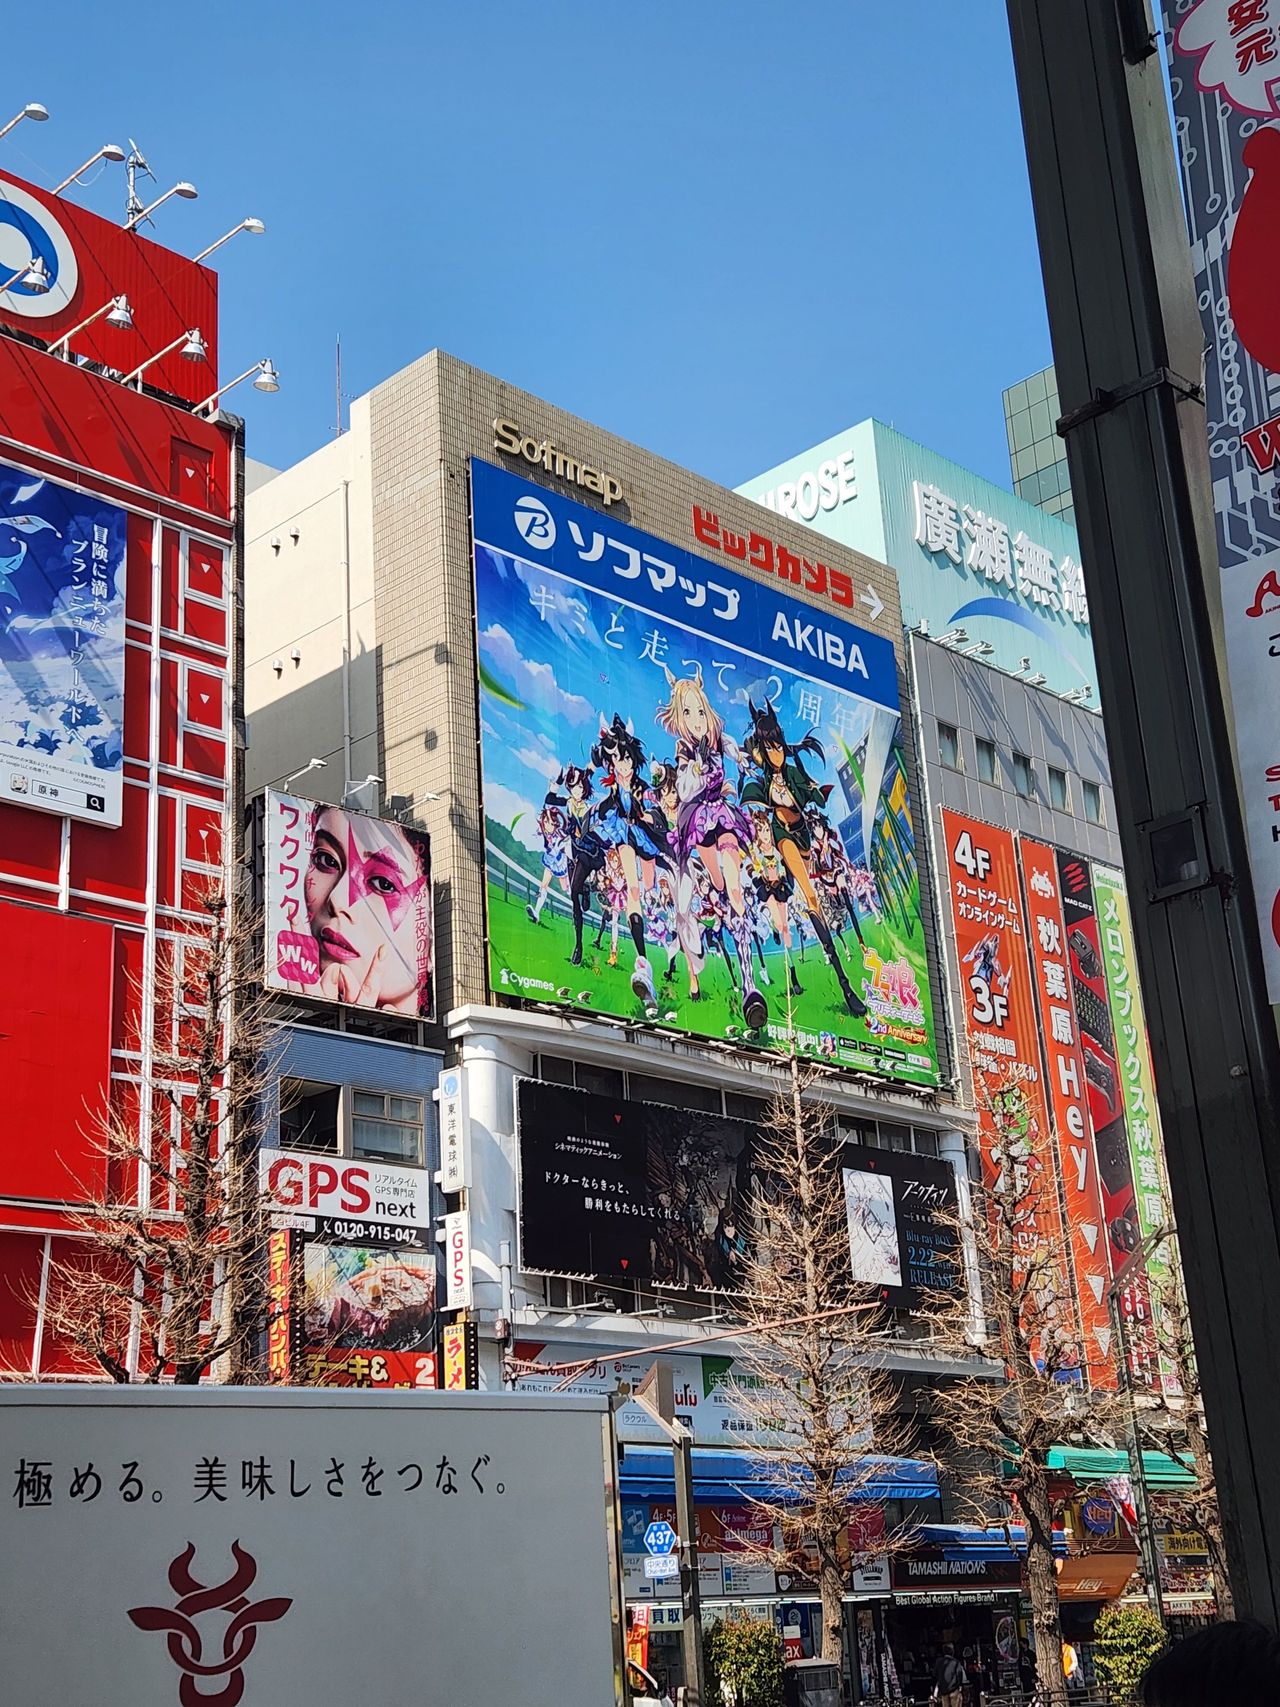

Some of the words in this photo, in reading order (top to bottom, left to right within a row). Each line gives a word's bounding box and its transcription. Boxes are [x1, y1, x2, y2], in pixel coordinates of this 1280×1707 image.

[492, 418, 623, 506] Sofmap
[693, 504, 854, 608] ビックカメラ
[91, 523, 109, 635] 冒険に満ちた
[567, 520, 740, 621] ソフマップ
[771, 612, 870, 680] AKIBA
[65, 538, 88, 743] ブランニューワールドへ
[37, 784, 59, 797] 原神
[279, 802, 300, 921] ワクワク
[954, 831, 991, 880] 4F
[957, 880, 1018, 914] カードゲーム
[958, 902, 1022, 935] オンラインゲーム
[510, 972, 555, 991] Cygames
[970, 977, 1009, 1027] 3F
[888, 1023, 928, 1044] Anniversary
[1036, 914, 1075, 1047] 秋葉原
[1056, 1055, 1088, 1191] Hey
[268, 1158, 371, 1215] GPS
[374, 1173, 418, 1189] リアルタイム
[544, 1170, 630, 1195] ドクターならきっと、
[375, 1201, 416, 1219] next
[584, 1196, 686, 1222] 勝利をもたらしてくれる。
[334, 1221, 417, 1243] 0120-915-047
[452, 1231, 464, 1287] GPS
[446, 1336, 462, 1390] ラーメ
[12, 1458, 163, 1508] 極める。
[193, 1454, 506, 1504] 美味しさをつなぐ。
[647, 1531, 672, 1545] 437
[908, 1561, 948, 1575] TAMASHII
[653, 1604, 680, 1624] 買取
[895, 1596, 911, 1606] Best
[911, 1595, 932, 1604] Global
[932, 1594, 953, 1605] Action
[953, 1594, 977, 1606] Figures
